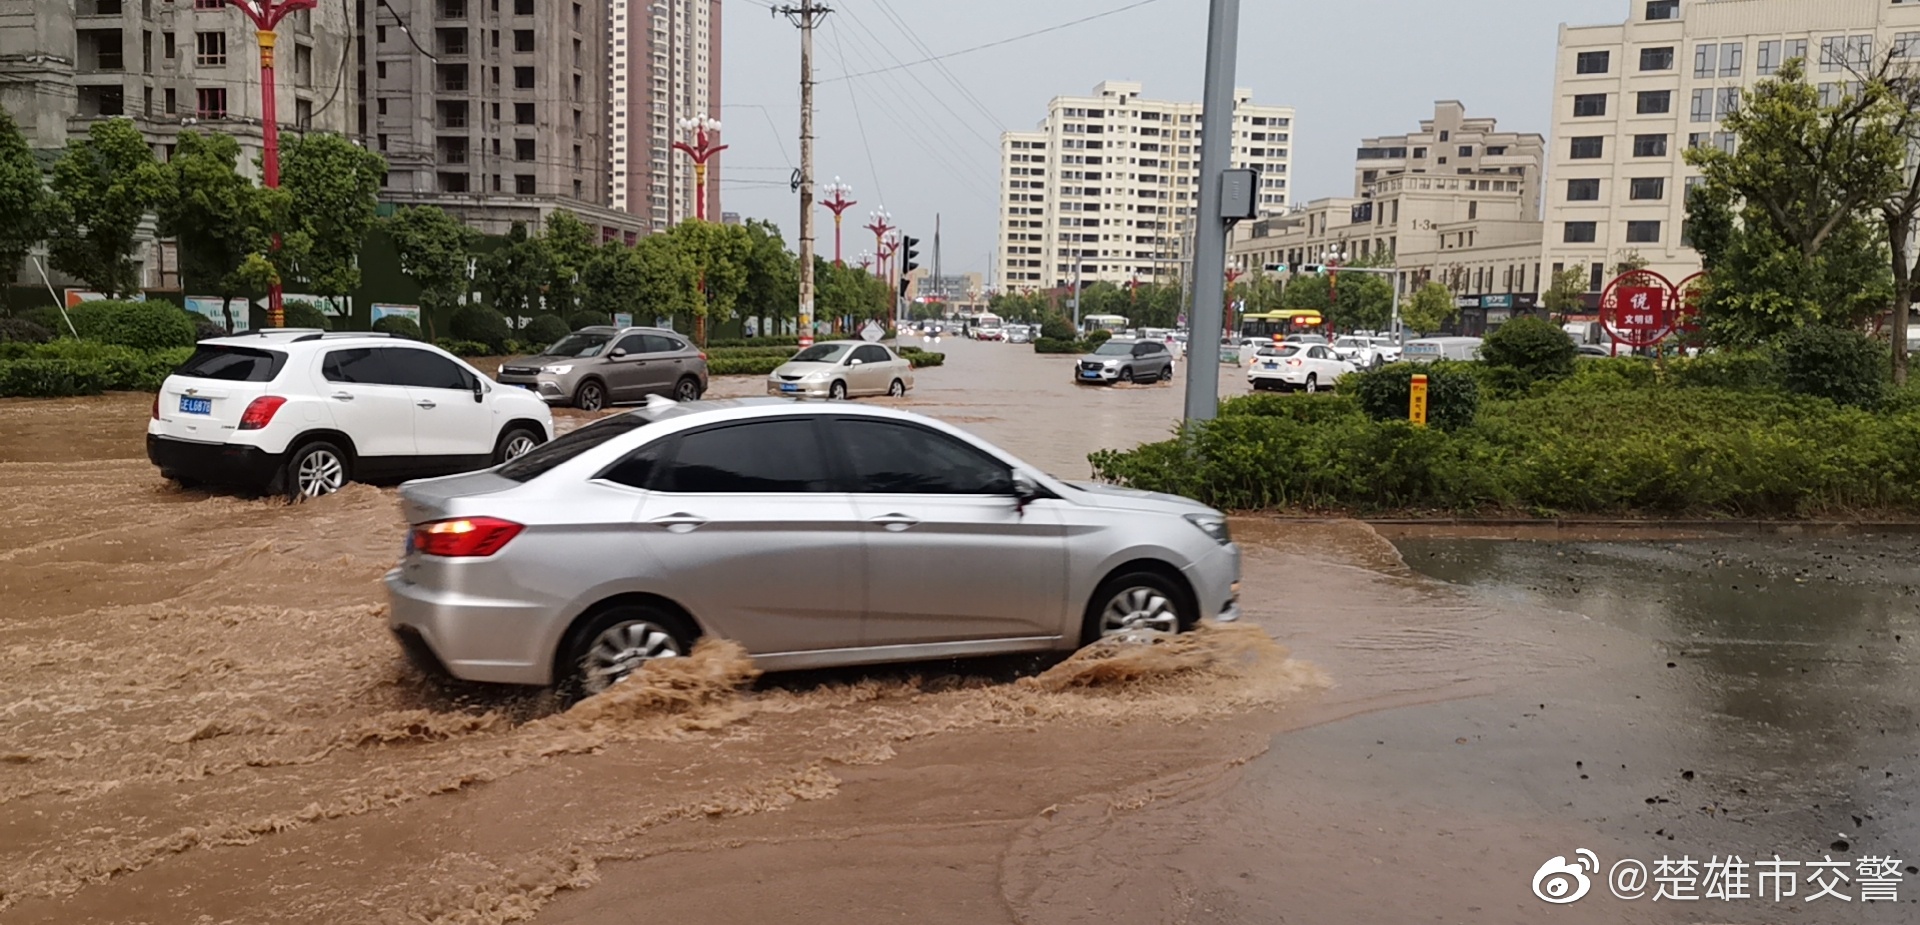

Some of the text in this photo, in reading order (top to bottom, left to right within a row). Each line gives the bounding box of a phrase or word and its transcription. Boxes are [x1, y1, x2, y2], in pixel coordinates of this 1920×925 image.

[1630, 292, 1650, 310] 说
[1624, 314, 1654, 325] 文明话
